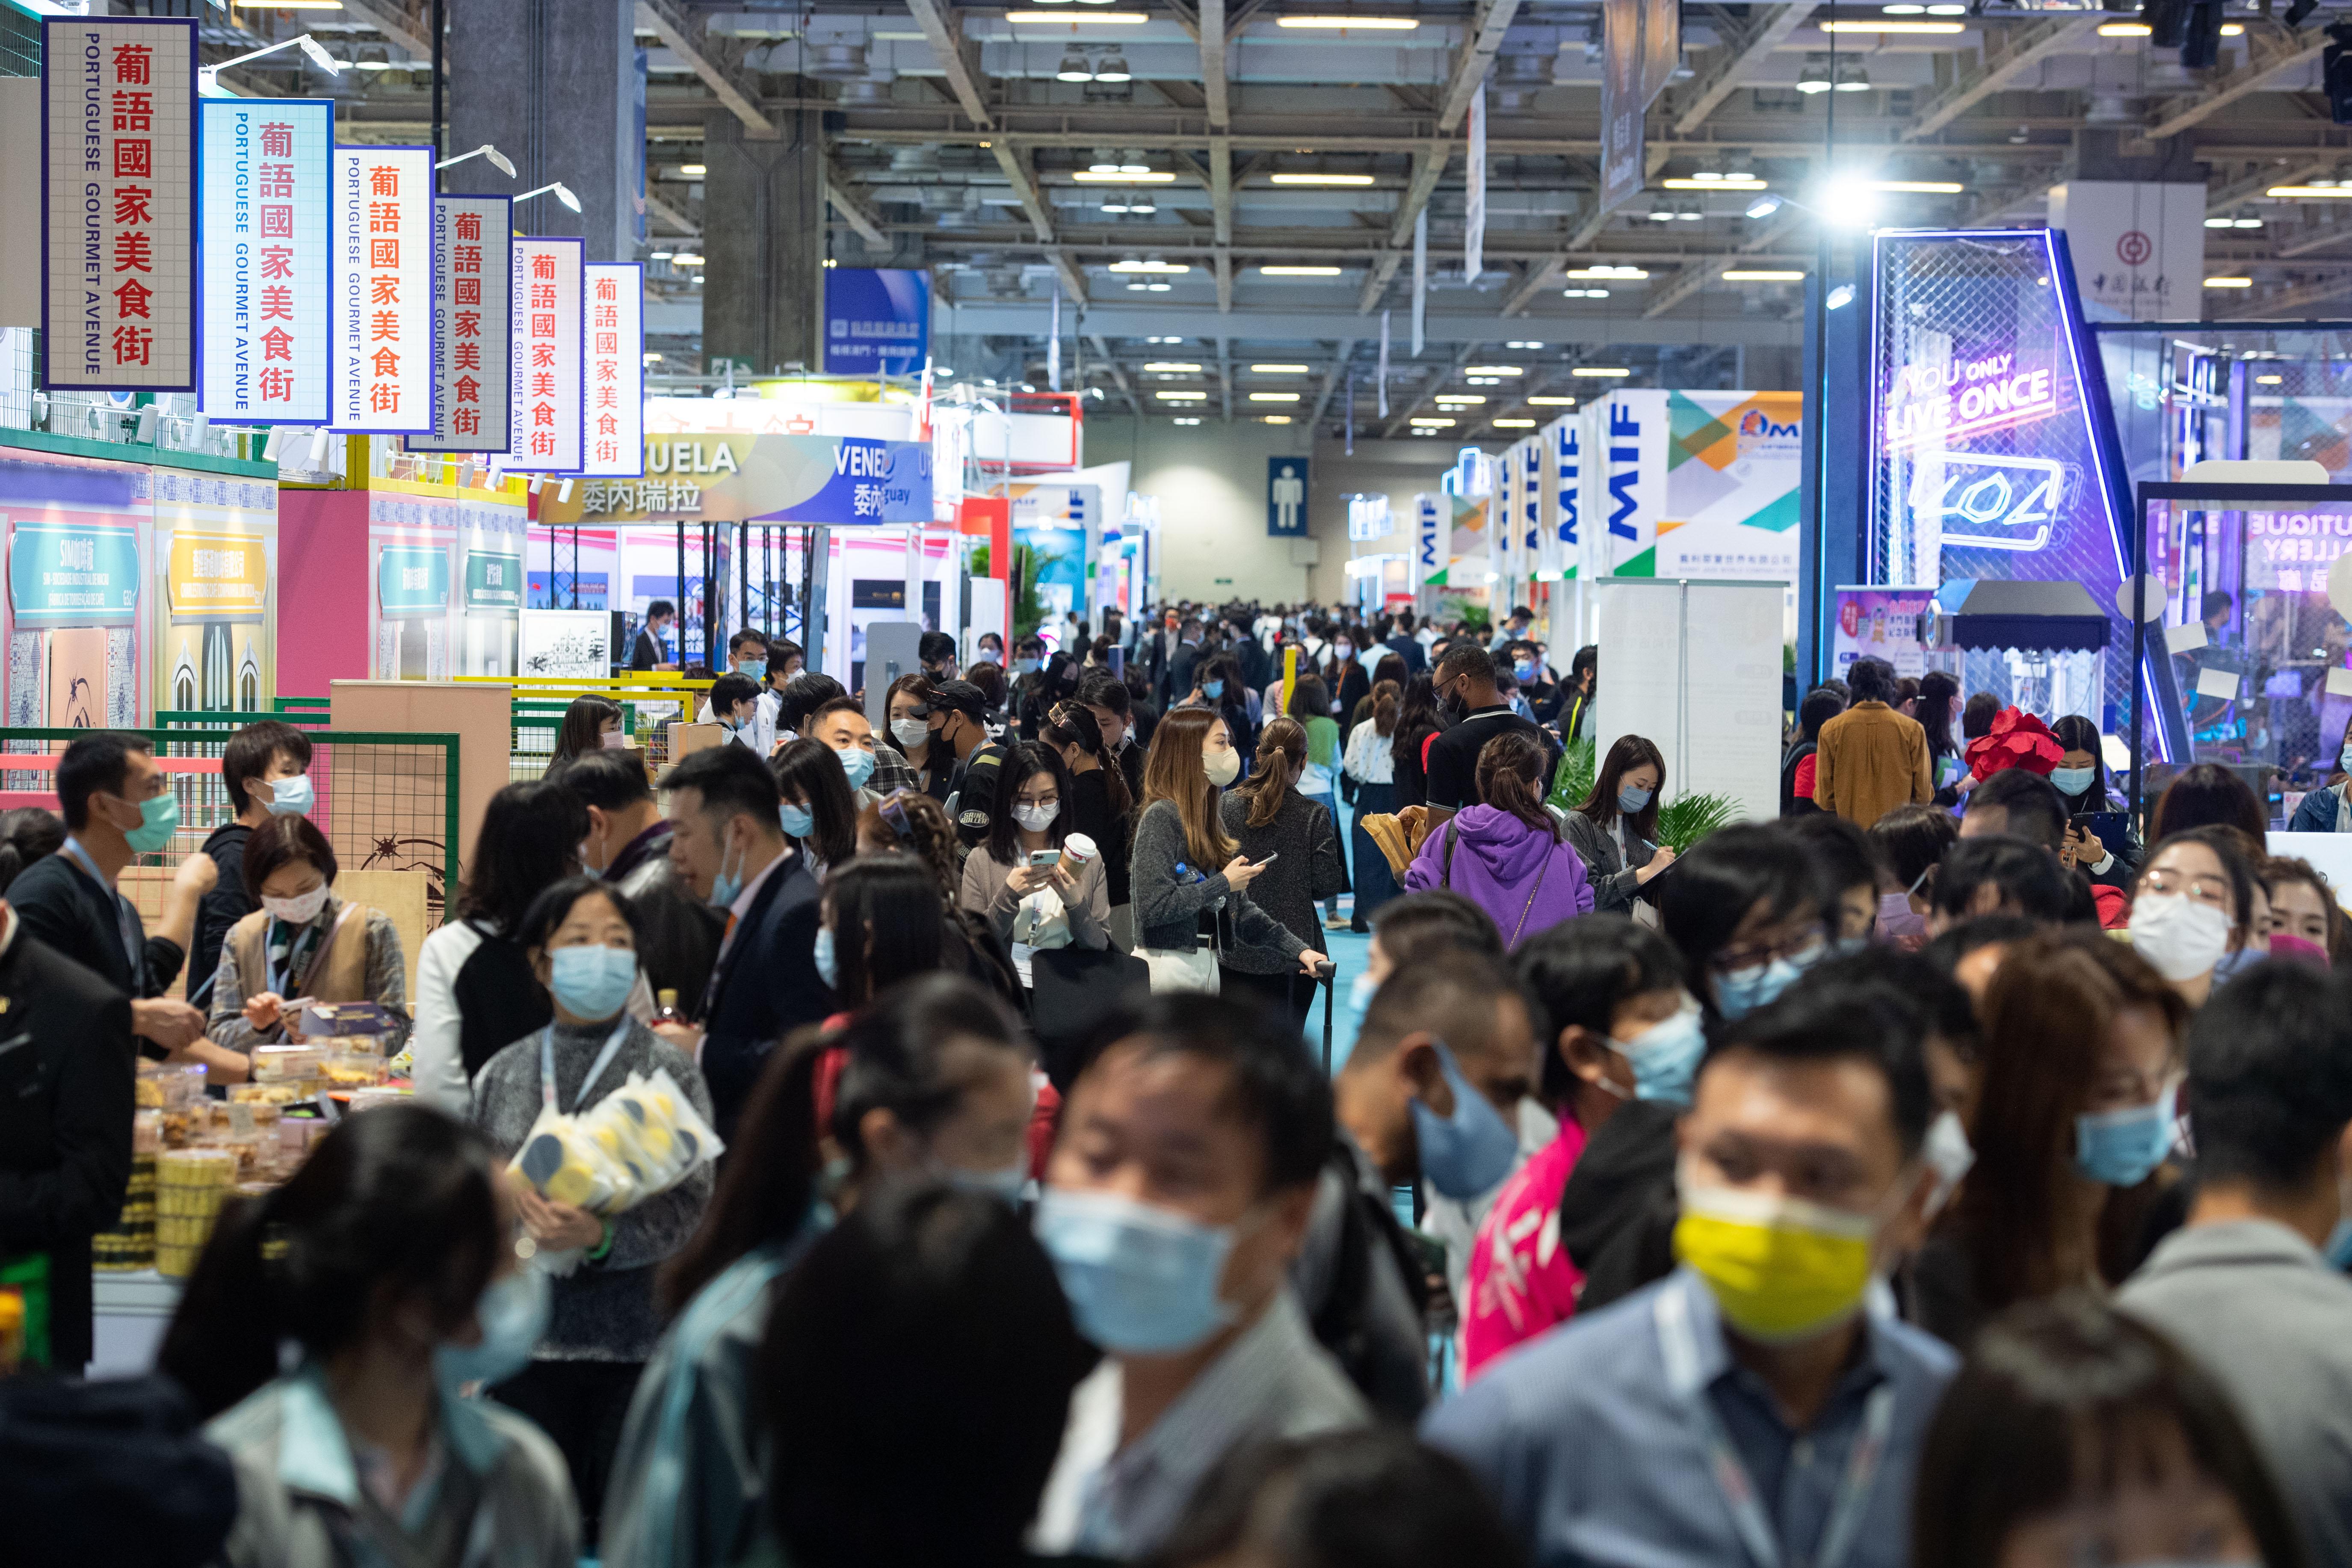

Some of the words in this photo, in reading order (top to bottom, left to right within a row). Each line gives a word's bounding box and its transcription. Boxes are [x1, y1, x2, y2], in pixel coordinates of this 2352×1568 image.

[86, 33, 100, 171] PORTUGUESE
[112, 44, 154, 366] 葡語國家美食街
[236, 113, 248, 232] PORTUGUESE
[348, 158, 360, 263] PORTUGUESE
[86, 183, 100, 286] GOURMET
[259, 122, 295, 402] 葡語國家美食街
[435, 205, 446, 301] PORTUGUESE
[236, 243, 248, 332] GOURMET
[349, 273, 360, 352] GOURMET
[369, 166, 401, 413] 葡語國家美食街
[452, 212, 482, 435] 葡語國家美食街
[514, 247, 524, 334] PORTUGUESE
[86, 293, 100, 374] AVENUE
[236, 337, 248, 410] AVENUE
[435, 308, 445, 380] GOURMET
[514, 341, 523, 406] GOURMET
[530, 254, 556, 456] 葡語國家美食街
[595, 278, 618, 462] 葡語國家美食街
[1905, 359, 1960, 396] YOU
[1965, 352, 2012, 381] ONLY
[349, 357, 360, 420] AVENUE
[434, 384, 445, 442] AVENUE
[1886, 394, 1952, 441] LIVE
[1959, 368, 2050, 420] ONCE
[513, 410, 523, 462] AVENUE
[645, 442, 738, 473] UELA
[1609, 403, 1639, 541] MIF
[1559, 426, 1580, 545] MIF
[123, 590, 132, 606] G32
